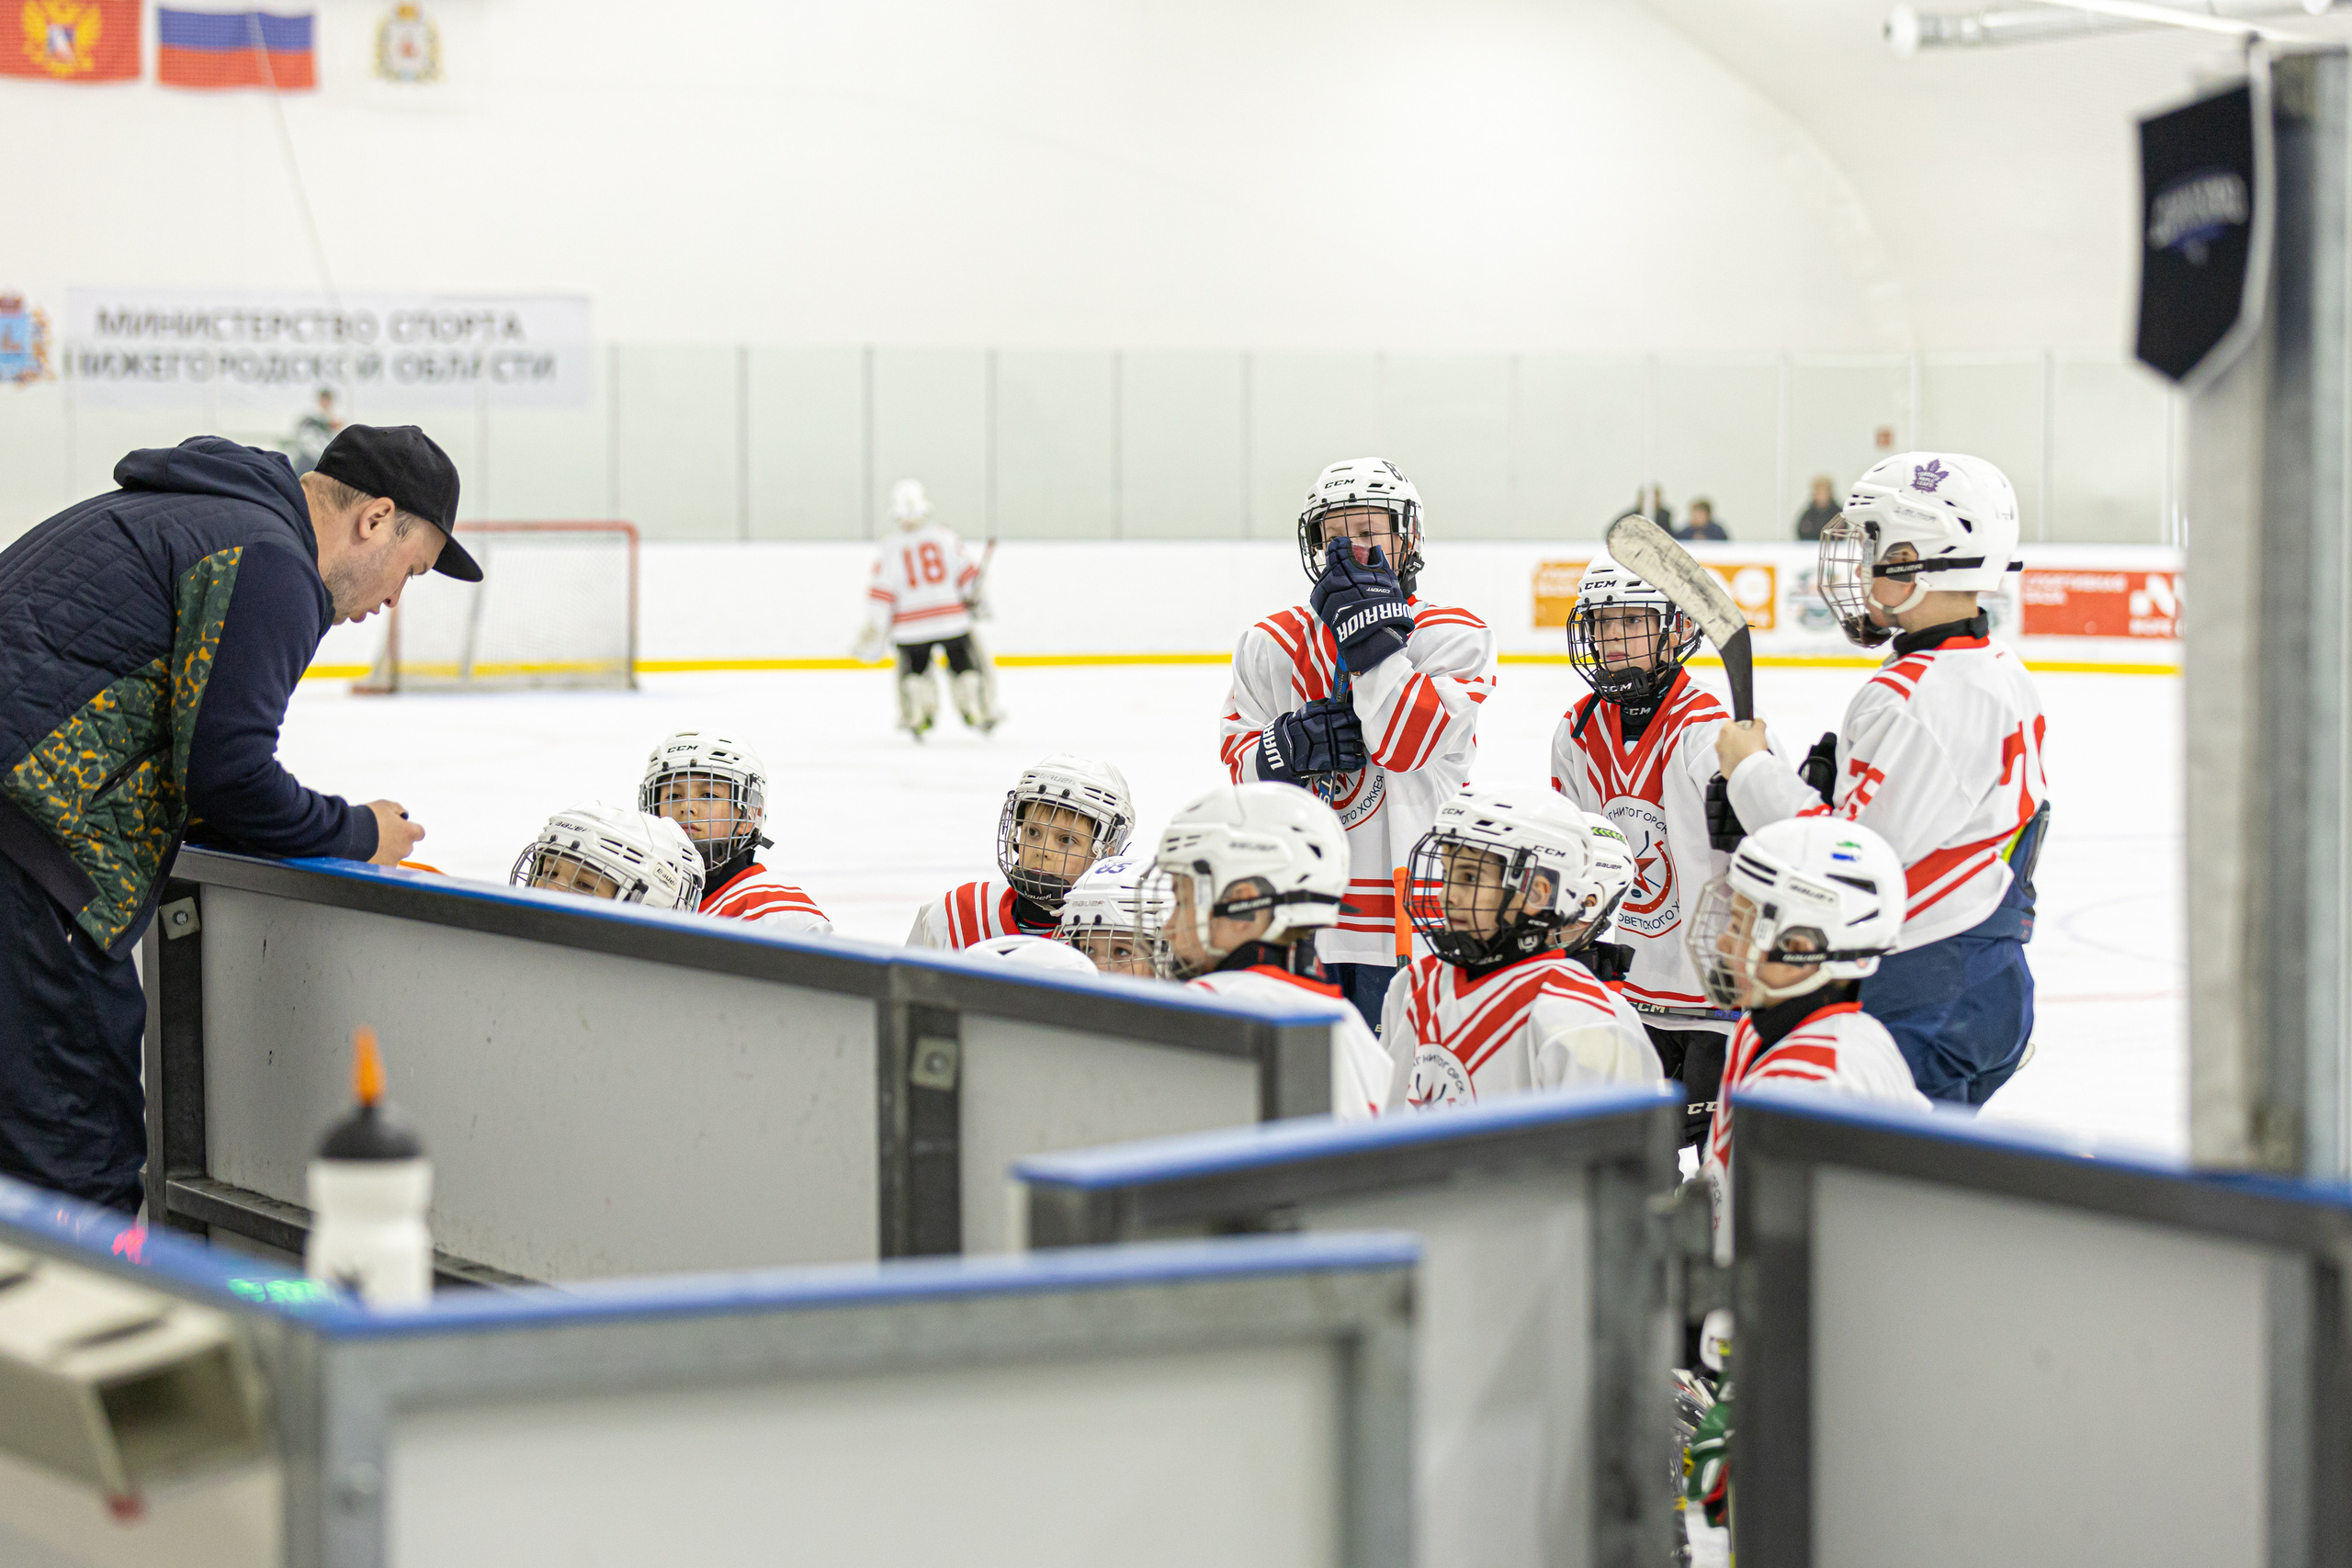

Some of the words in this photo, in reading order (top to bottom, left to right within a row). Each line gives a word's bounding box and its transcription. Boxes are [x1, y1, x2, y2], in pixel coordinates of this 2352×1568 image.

[95, 306, 379, 344] МИНИСТЕРСТВО
[387, 308, 526, 344] СПОРТА
[391, 348, 557, 385] ОБЛАСТИ
[1324, 479, 1355, 490] CCM
[902, 540, 947, 588] 18
[1885, 564, 1924, 574] BAUER
[1584, 580, 1617, 591] CCM
[1336, 603, 1414, 643] WARRIOR
[667, 744, 698, 753] CCM
[1357, 774, 1385, 815] ХОККЕЯ
[1442, 808, 1465, 817] CCM
[1606, 806, 1668, 835] ГНИТОГОРСК
[1533, 844, 1566, 858] CCM
[1595, 862, 1623, 870] BAUER
[1071, 899, 1105, 908] BAUER
[1618, 909, 1675, 931] ОВЕТСКОГО
